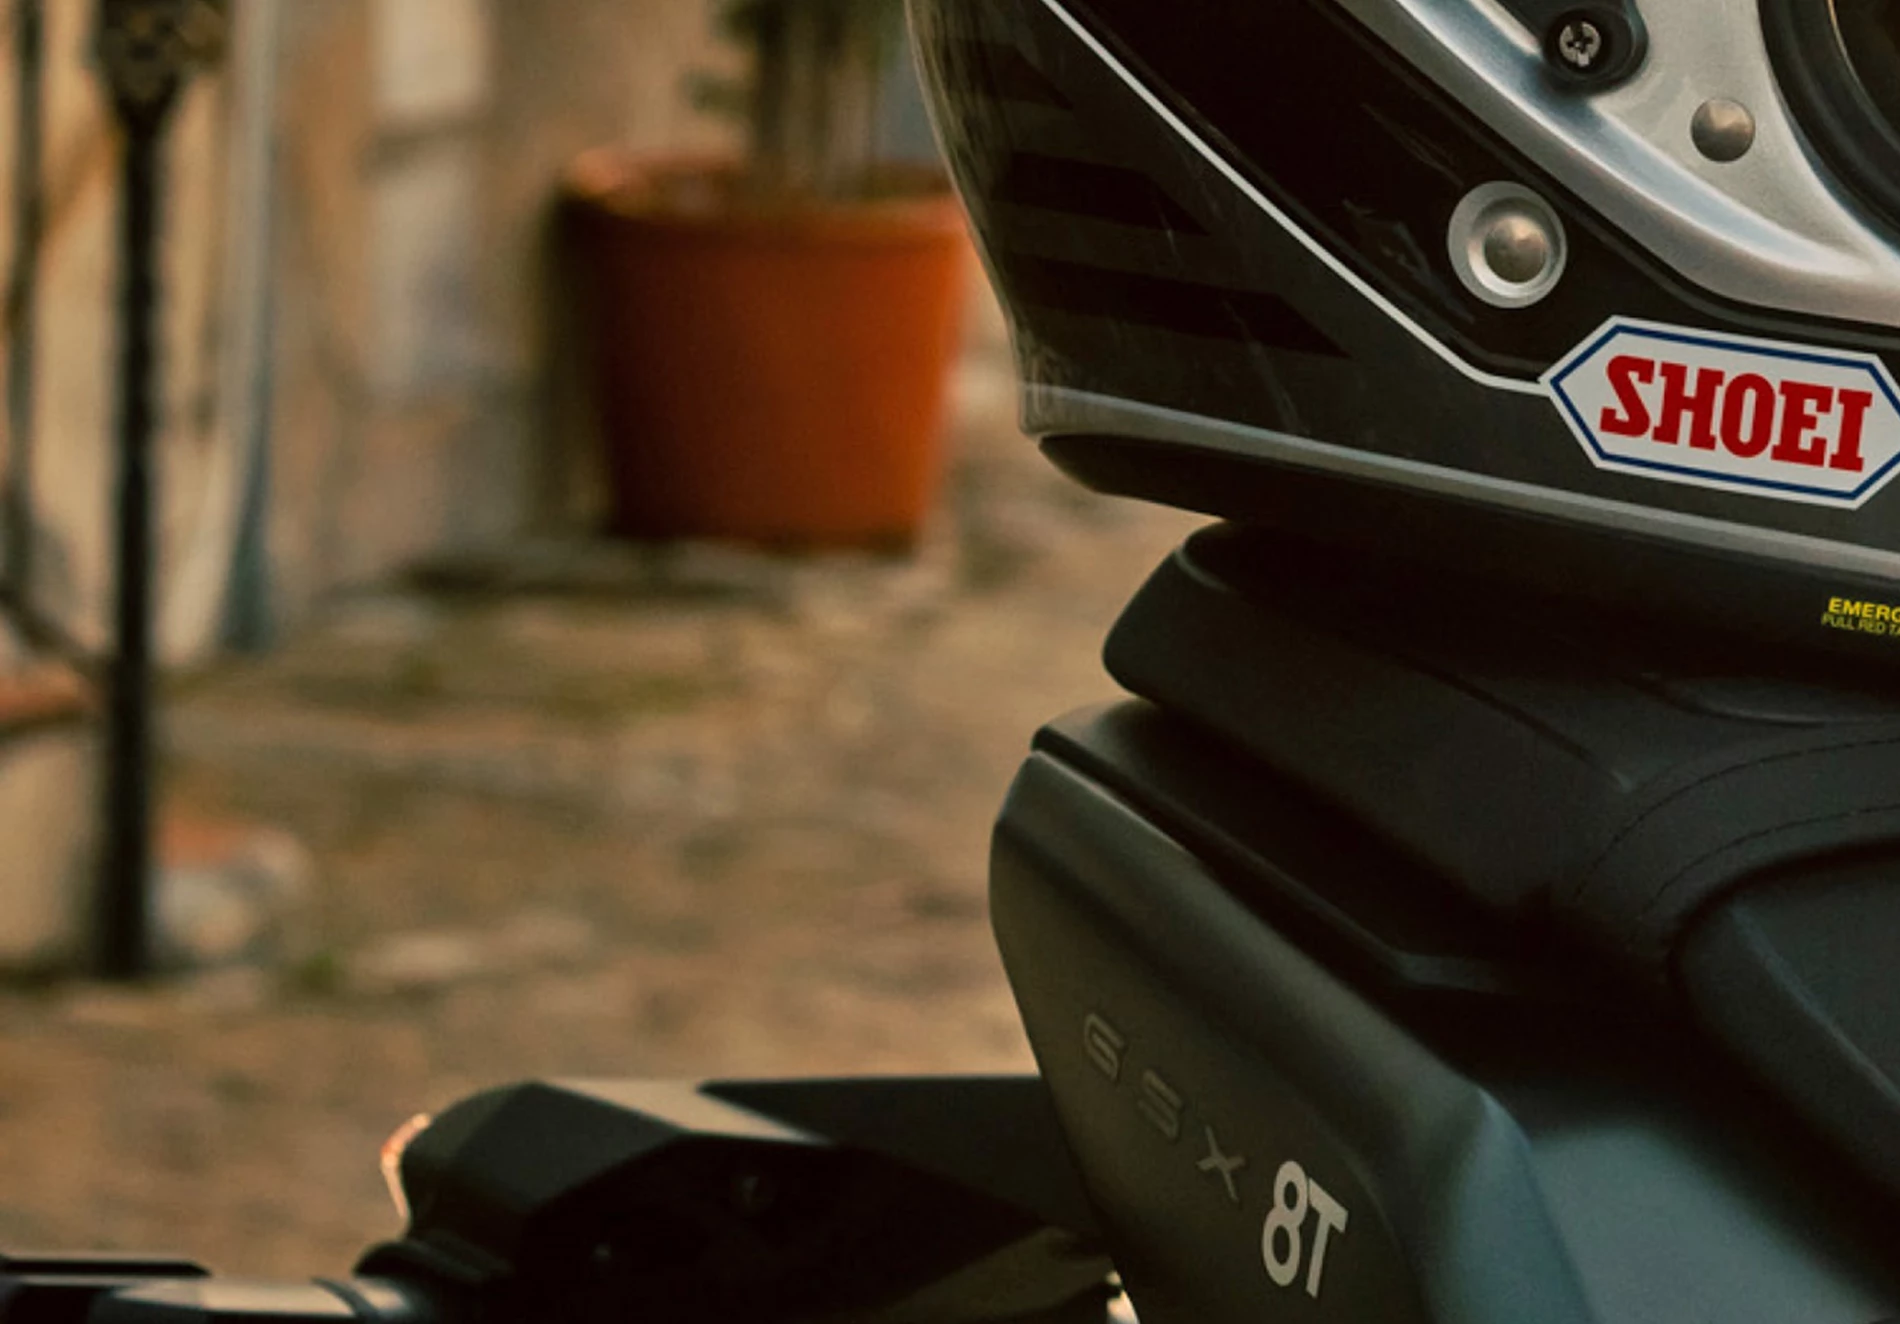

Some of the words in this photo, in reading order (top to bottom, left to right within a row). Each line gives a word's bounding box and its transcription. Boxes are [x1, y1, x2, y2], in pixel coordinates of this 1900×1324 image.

[1599, 353, 1873, 473] SHOEI
[1821, 612, 1855, 631] PULL
[1858, 618, 1886, 635] RED
[1261, 1159, 1349, 1300] 8T
